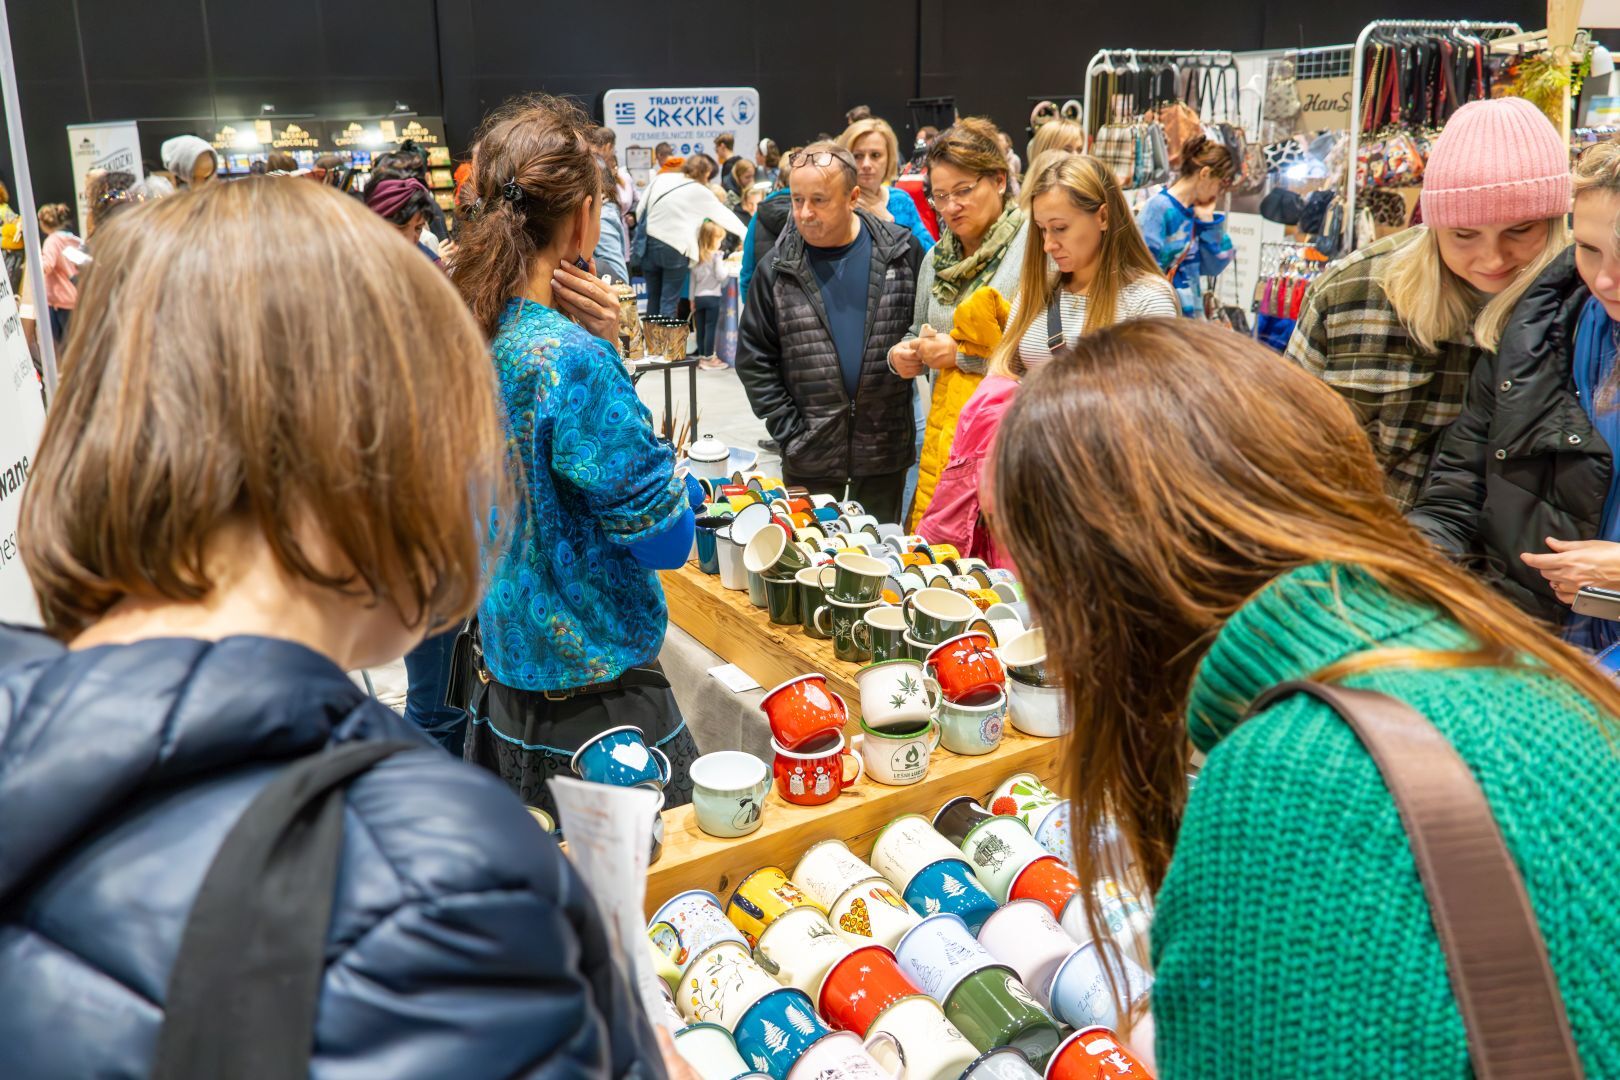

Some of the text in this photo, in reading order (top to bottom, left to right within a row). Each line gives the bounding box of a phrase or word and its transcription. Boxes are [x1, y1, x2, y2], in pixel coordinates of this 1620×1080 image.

[649, 96, 719, 105] TRADYCYJNE
[645, 106, 725, 127] GRECKIE
[272, 138, 319, 148] CHOCOLATE
